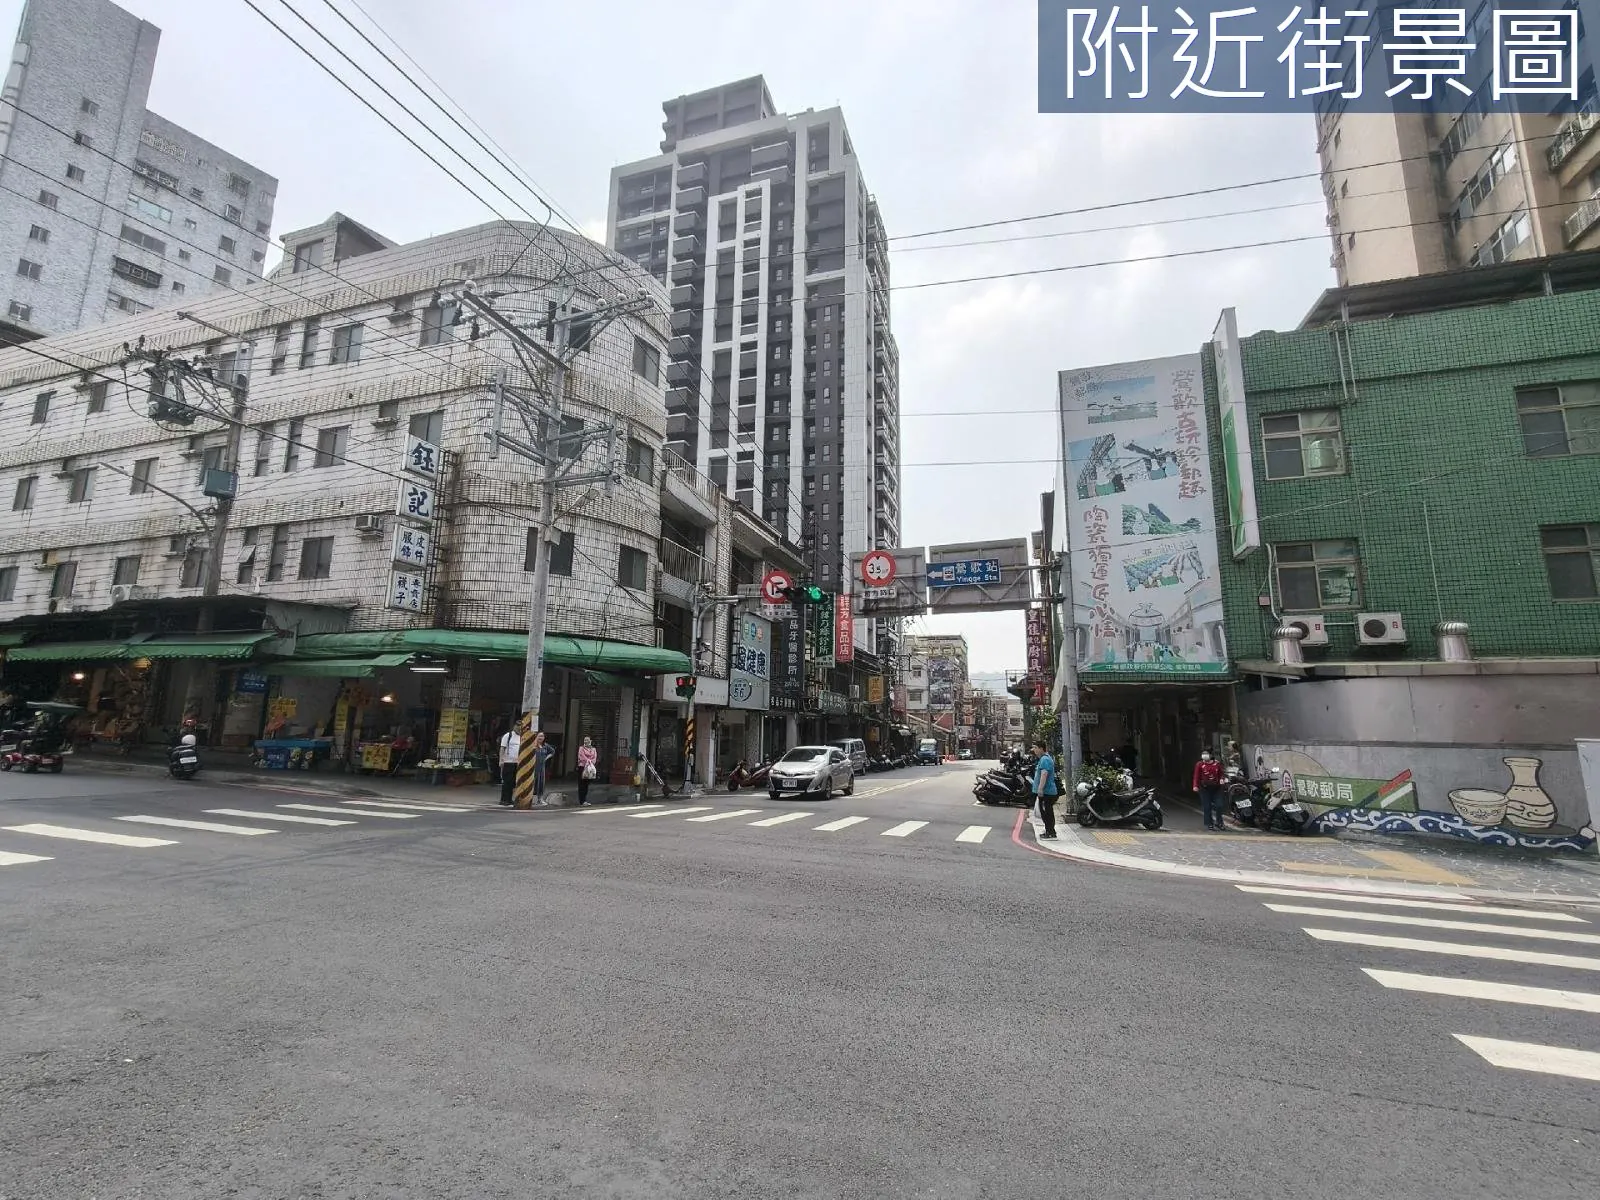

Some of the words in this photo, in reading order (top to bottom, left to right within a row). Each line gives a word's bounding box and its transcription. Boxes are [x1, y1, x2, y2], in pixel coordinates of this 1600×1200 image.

[408, 442, 435, 517] 鈺記
[414, 534, 425, 562] 皮件
[955, 561, 998, 574] 鶯歌站
[1296, 779, 1353, 802] 鶯歌郵局
